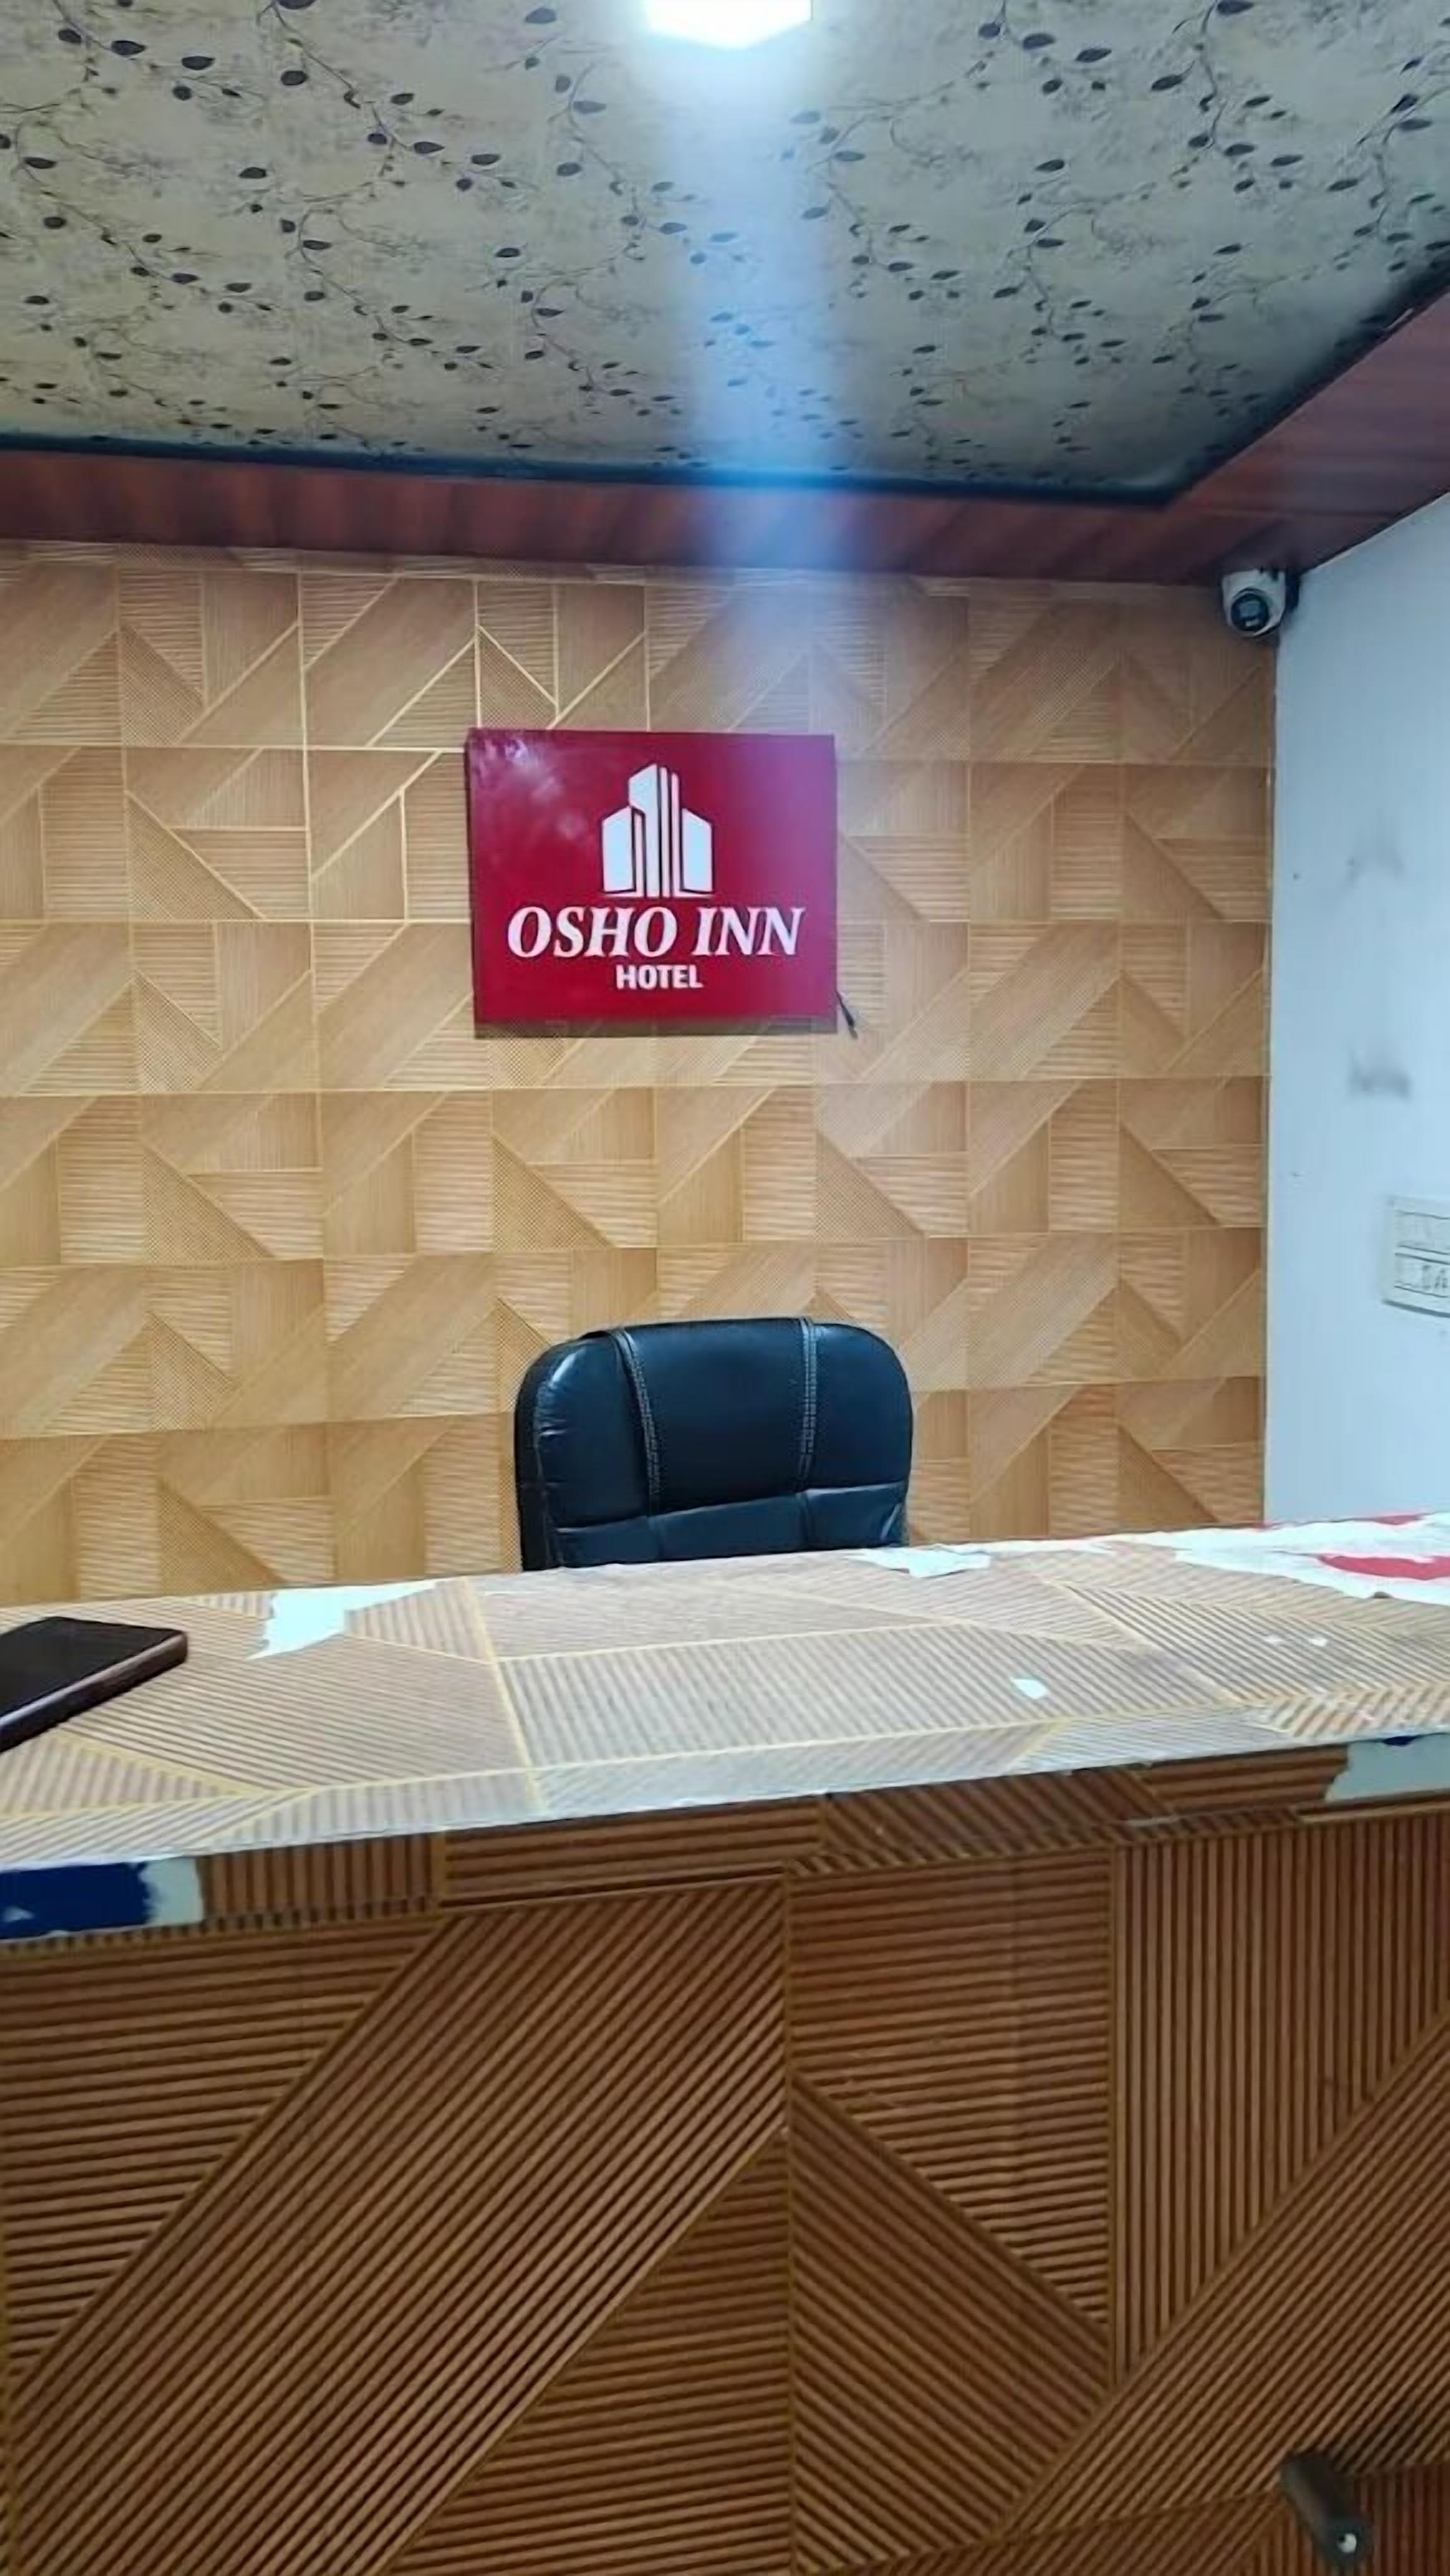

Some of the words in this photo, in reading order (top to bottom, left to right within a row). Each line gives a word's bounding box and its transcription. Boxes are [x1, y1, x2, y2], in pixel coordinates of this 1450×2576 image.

[507, 906, 678, 958] OSHO
[692, 906, 805, 957] INN
[616, 964, 704, 989] HOTEL
